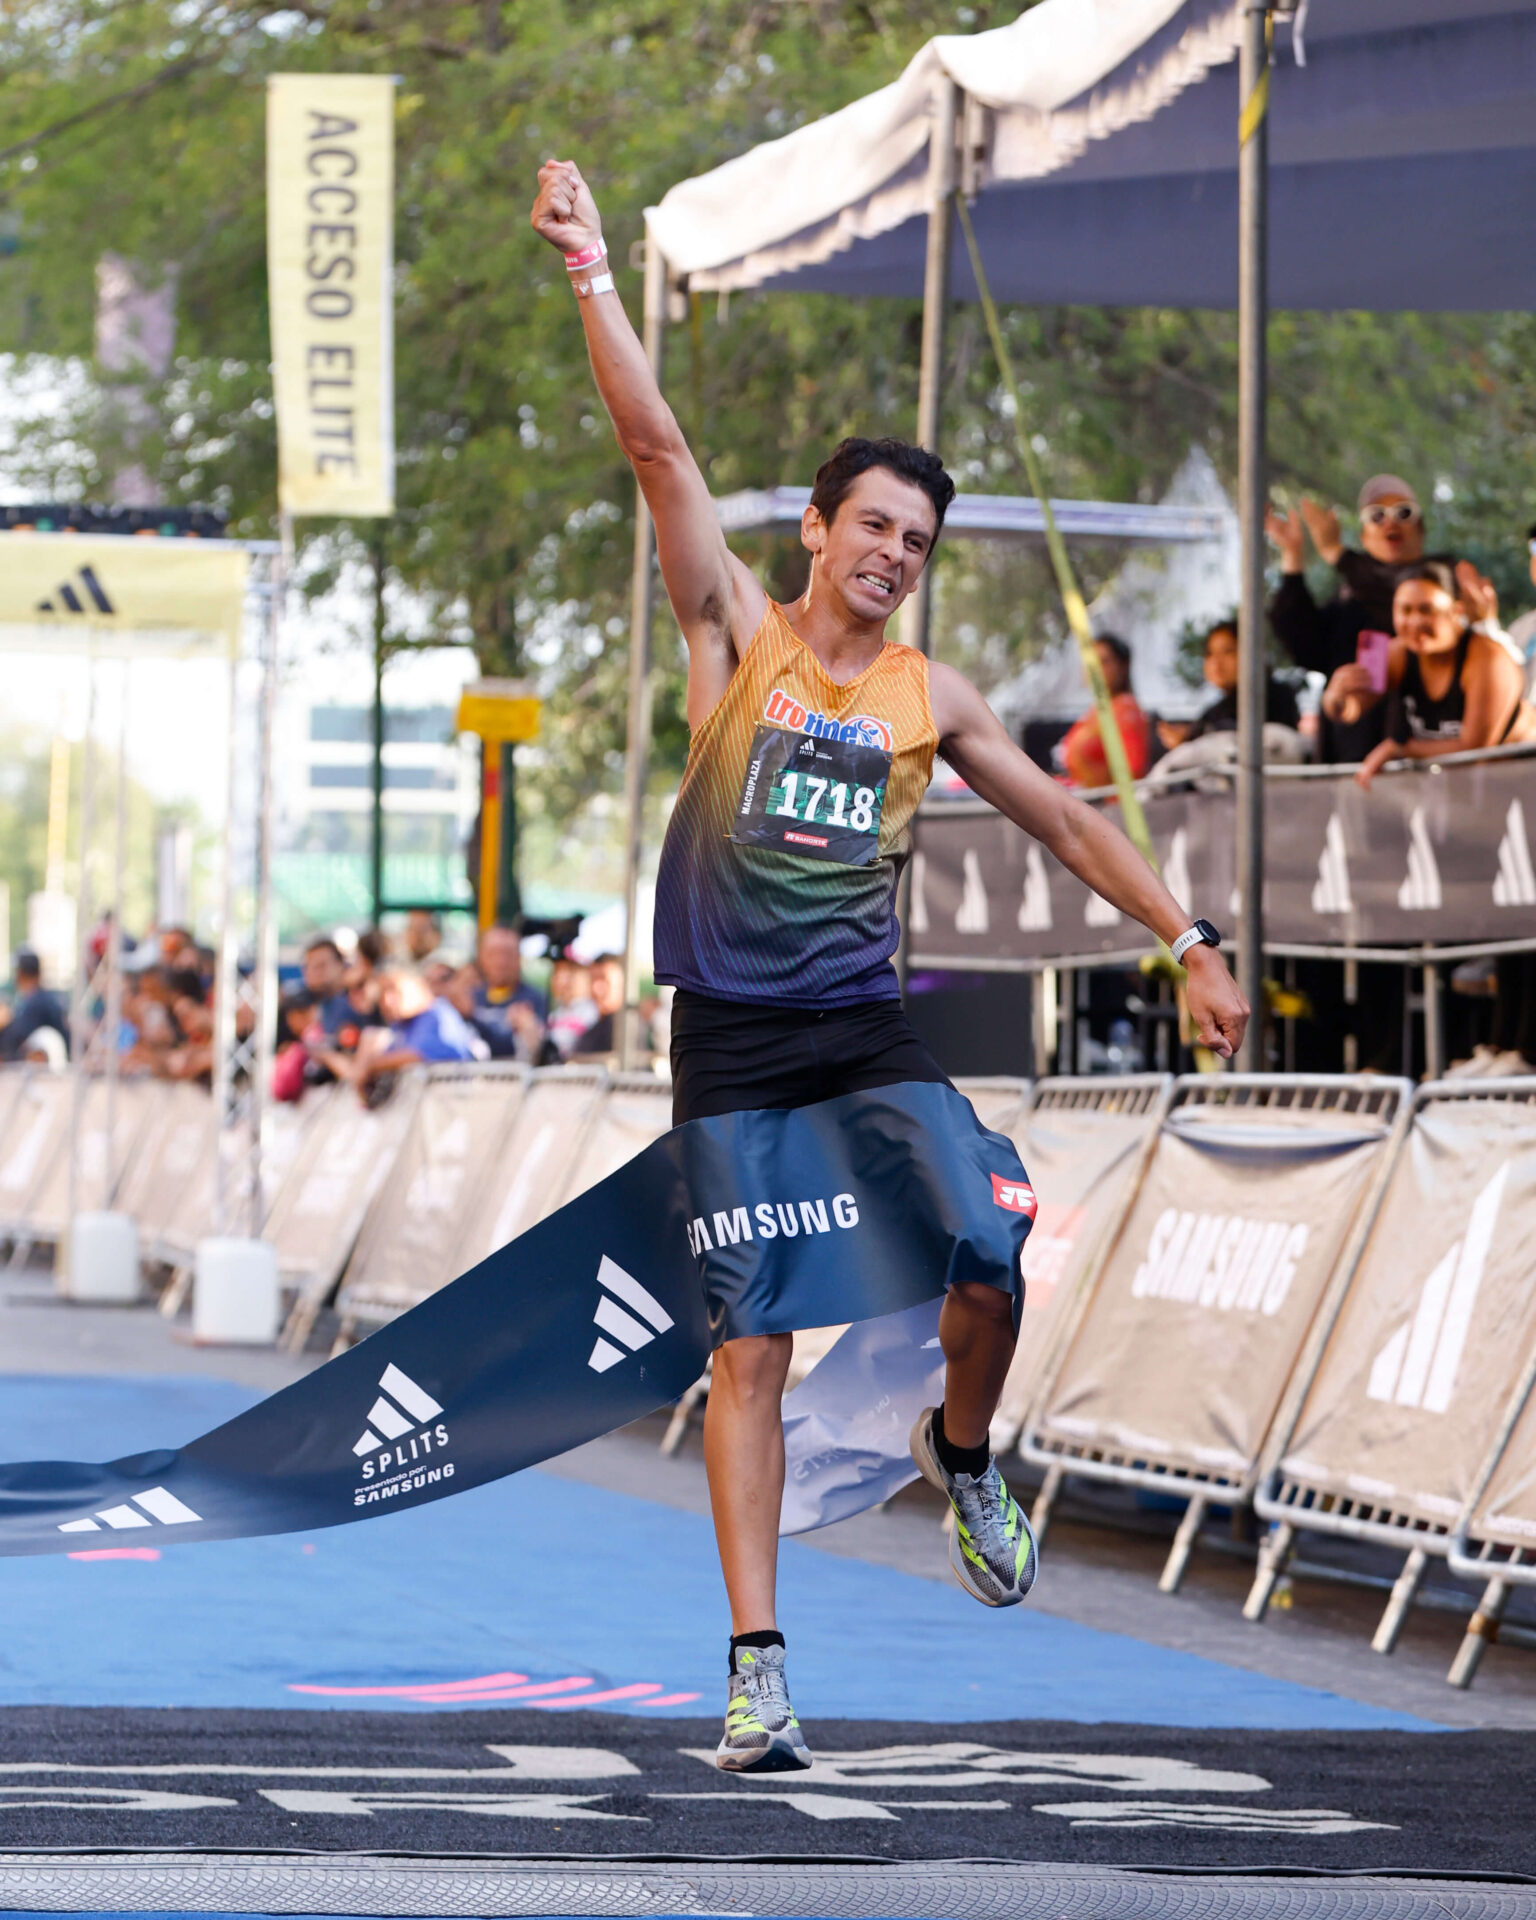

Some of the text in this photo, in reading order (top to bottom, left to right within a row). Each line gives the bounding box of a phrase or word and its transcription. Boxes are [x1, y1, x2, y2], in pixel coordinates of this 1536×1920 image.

[306, 109, 358, 477] ACCESO ELITE
[741, 760, 761, 815] MACROPLAZA
[775, 772, 876, 832] 1718
[1132, 1207, 1310, 1317] SAMSUNG
[354, 1465, 428, 1494] Presentado por:
[361, 1423, 449, 1480] SPLITS
[353, 1463, 456, 1506] SAMSUNG
